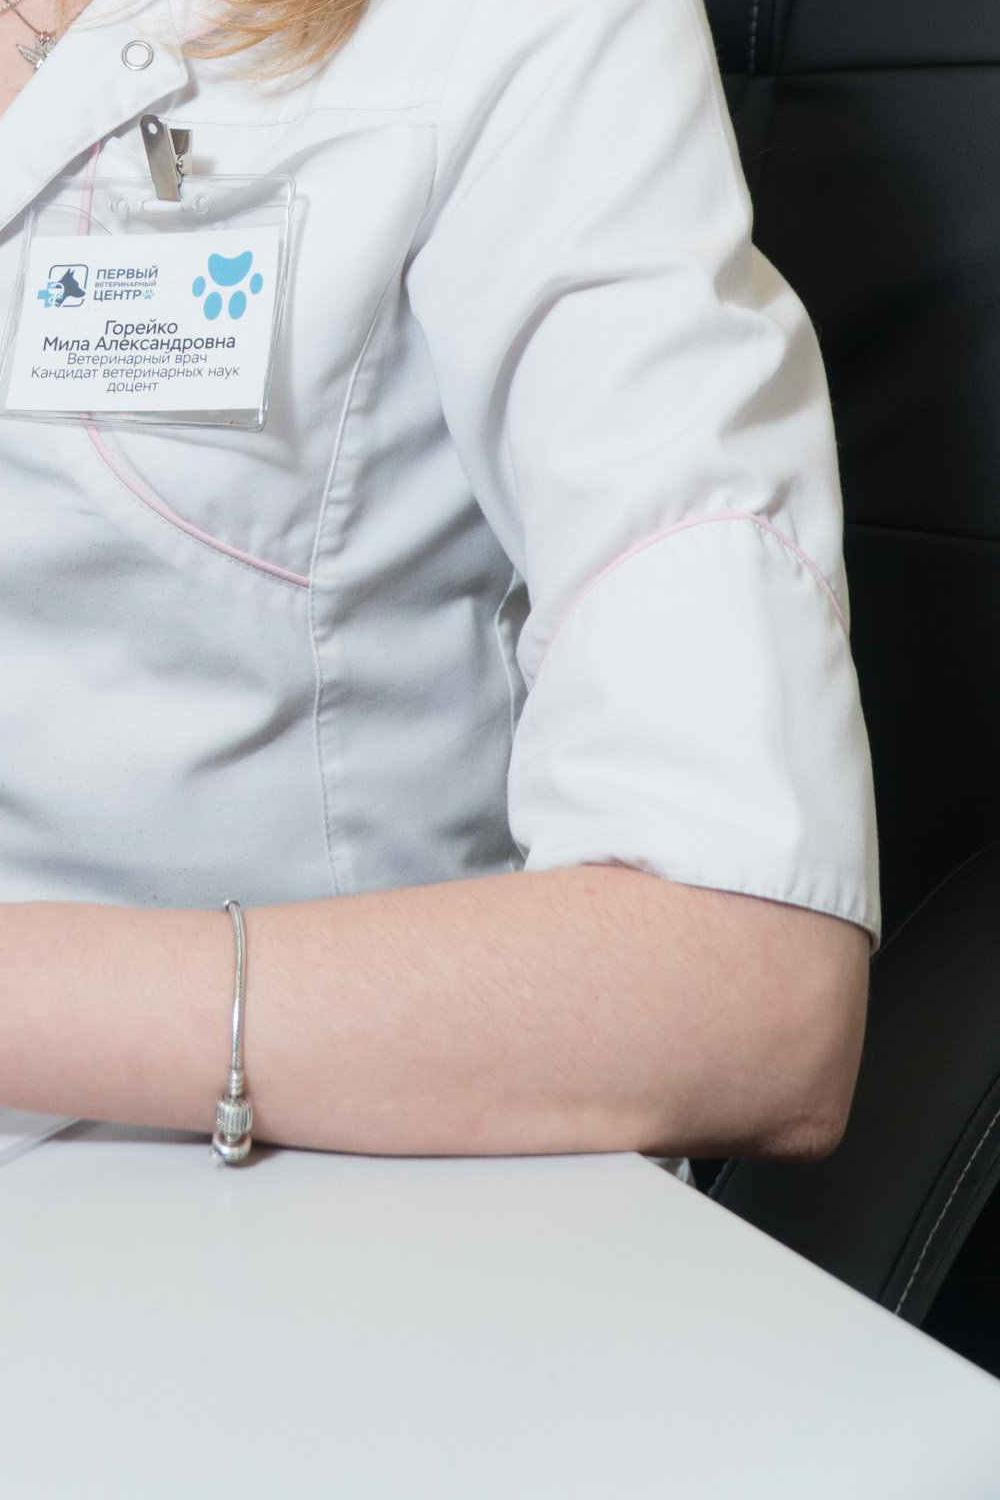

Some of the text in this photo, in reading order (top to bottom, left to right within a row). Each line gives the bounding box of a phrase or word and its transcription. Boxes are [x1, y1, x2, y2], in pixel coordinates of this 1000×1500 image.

[96, 265, 159, 280] ПЕРВЫЙ
[94, 280, 157, 288] ВЕТЕРИНАРНЫЙ
[93, 288, 142, 302] ЦЕНТР
[104, 319, 178, 339] Горейко
[43, 335, 236, 353] Мила Александровна
[67, 351, 208, 366] Ветеринарный врач
[31, 366, 240, 381] Кандидат ветеринарных наук
[106, 380, 159, 394] доцент
